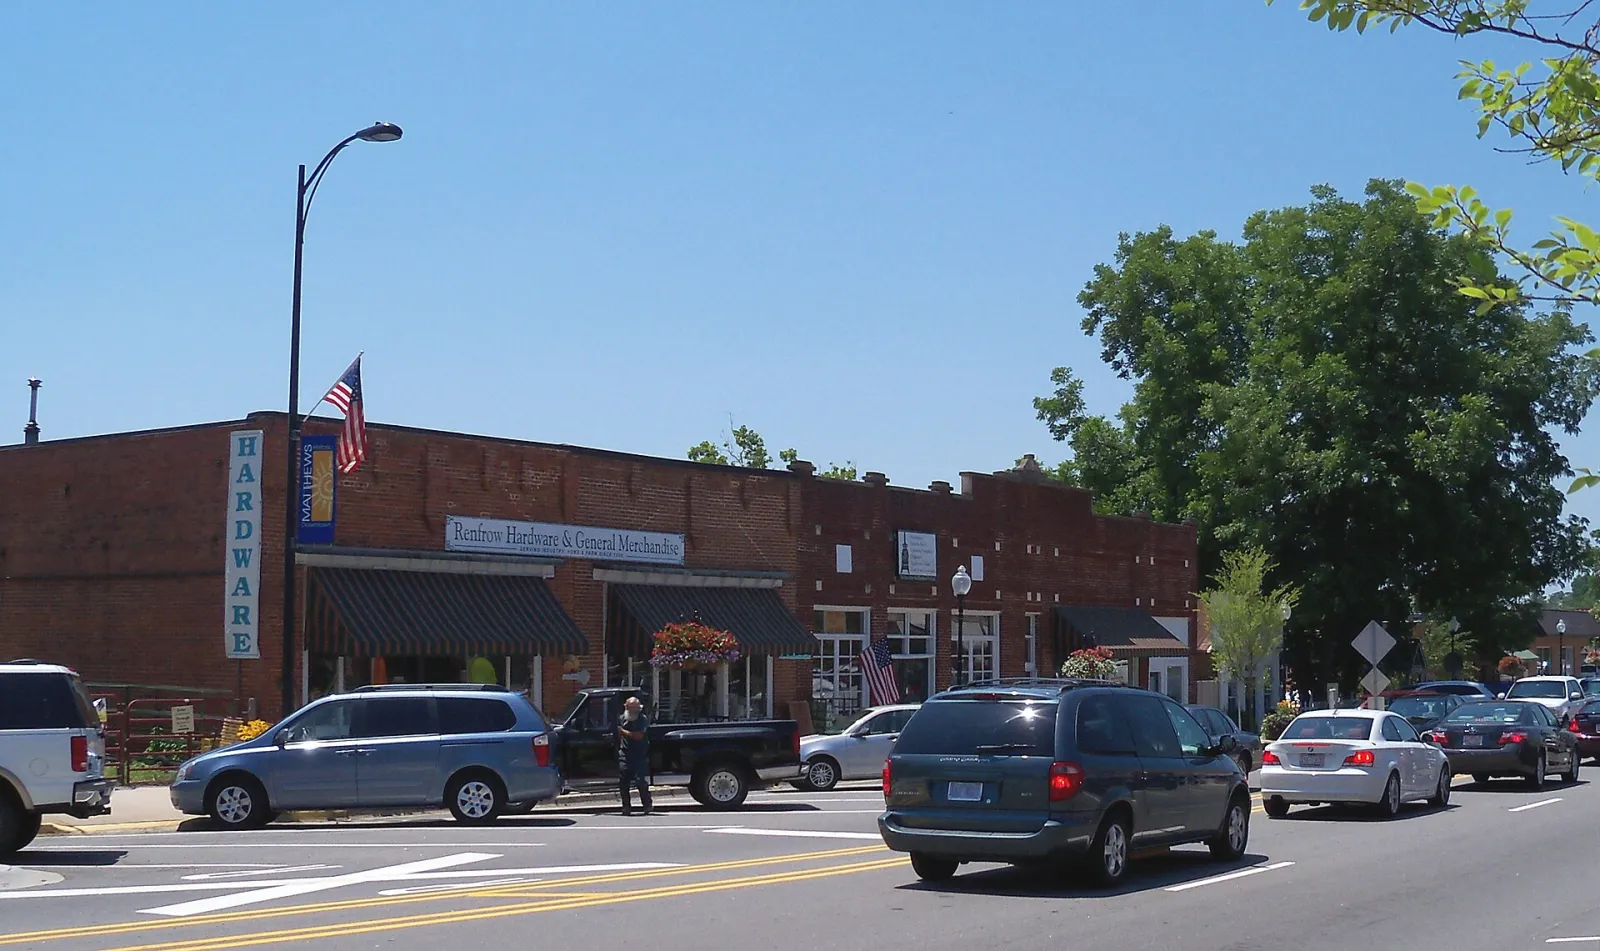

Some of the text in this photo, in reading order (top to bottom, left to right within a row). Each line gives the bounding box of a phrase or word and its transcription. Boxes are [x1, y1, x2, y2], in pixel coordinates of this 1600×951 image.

[302, 444, 313, 522] MATTHEWS
[231, 436, 257, 653] HARDWARE
[454, 521, 679, 556] Renfrow Hardware & General Merchandise
